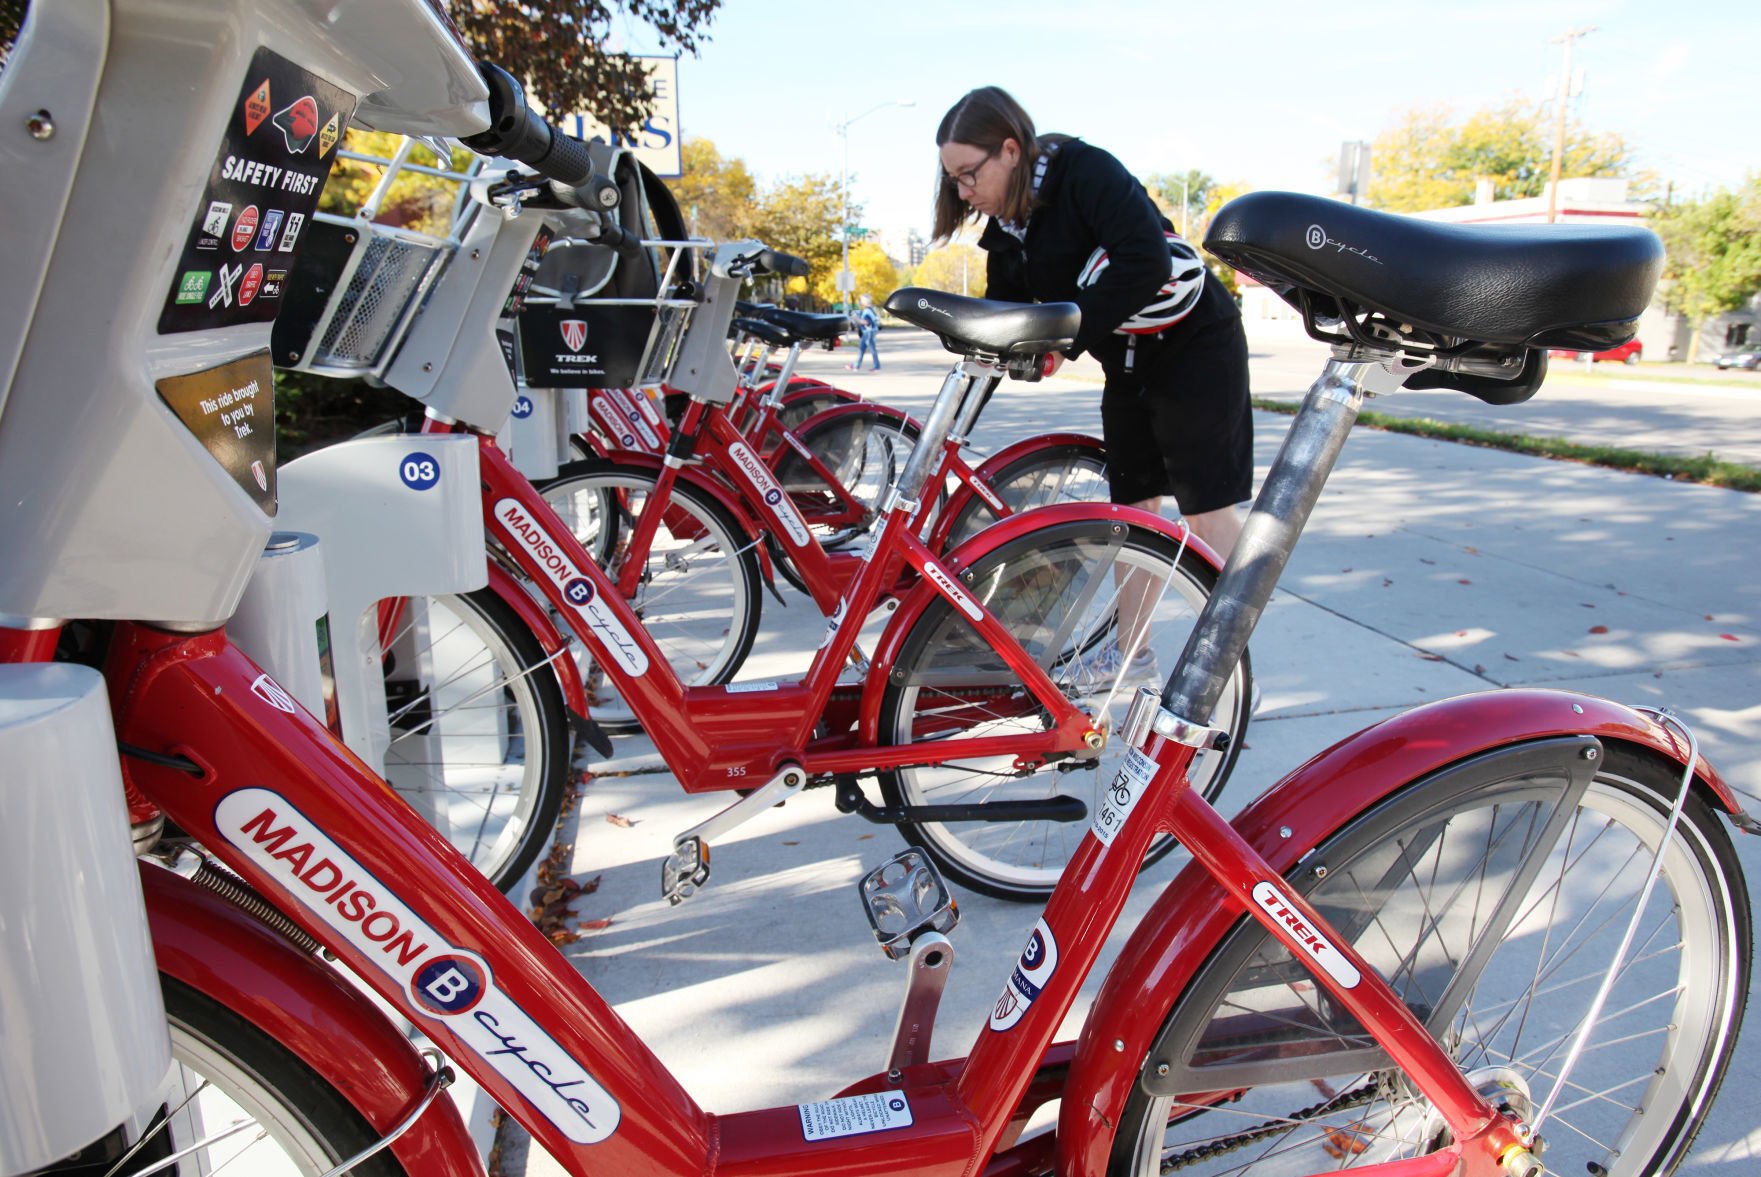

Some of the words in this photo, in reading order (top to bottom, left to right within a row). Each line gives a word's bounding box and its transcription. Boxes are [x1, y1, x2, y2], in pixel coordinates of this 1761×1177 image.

[222, 155, 282, 188] SAFETY
[281, 170, 318, 195] FIRST
[555, 354, 598, 363] TREK
[200, 398, 218, 415] This
[218, 393, 234, 409] ride
[232, 380, 260, 402] brought
[512, 401, 530, 414] 04
[221, 413, 231, 426] to
[230, 407, 244, 424] you
[243, 402, 255, 416] by
[598, 401, 626, 436] MADISON
[234, 422, 253, 440] Trek.
[403, 461, 435, 481] 03
[733, 448, 771, 491] MADISON
[503, 507, 572, 581] MADISON
[569, 582, 590, 601] B
[930, 566, 964, 601] TREK
[727, 767, 746, 777] 355
[1264, 890, 1328, 954] TREK
[1025, 937, 1038, 961] B
[241, 808, 429, 966] MADISON
[425, 967, 469, 1003] B
[474, 1010, 598, 1129] cycle
[1013, 970, 1032, 996] MANA
[801, 1104, 814, 1134] WARNING
